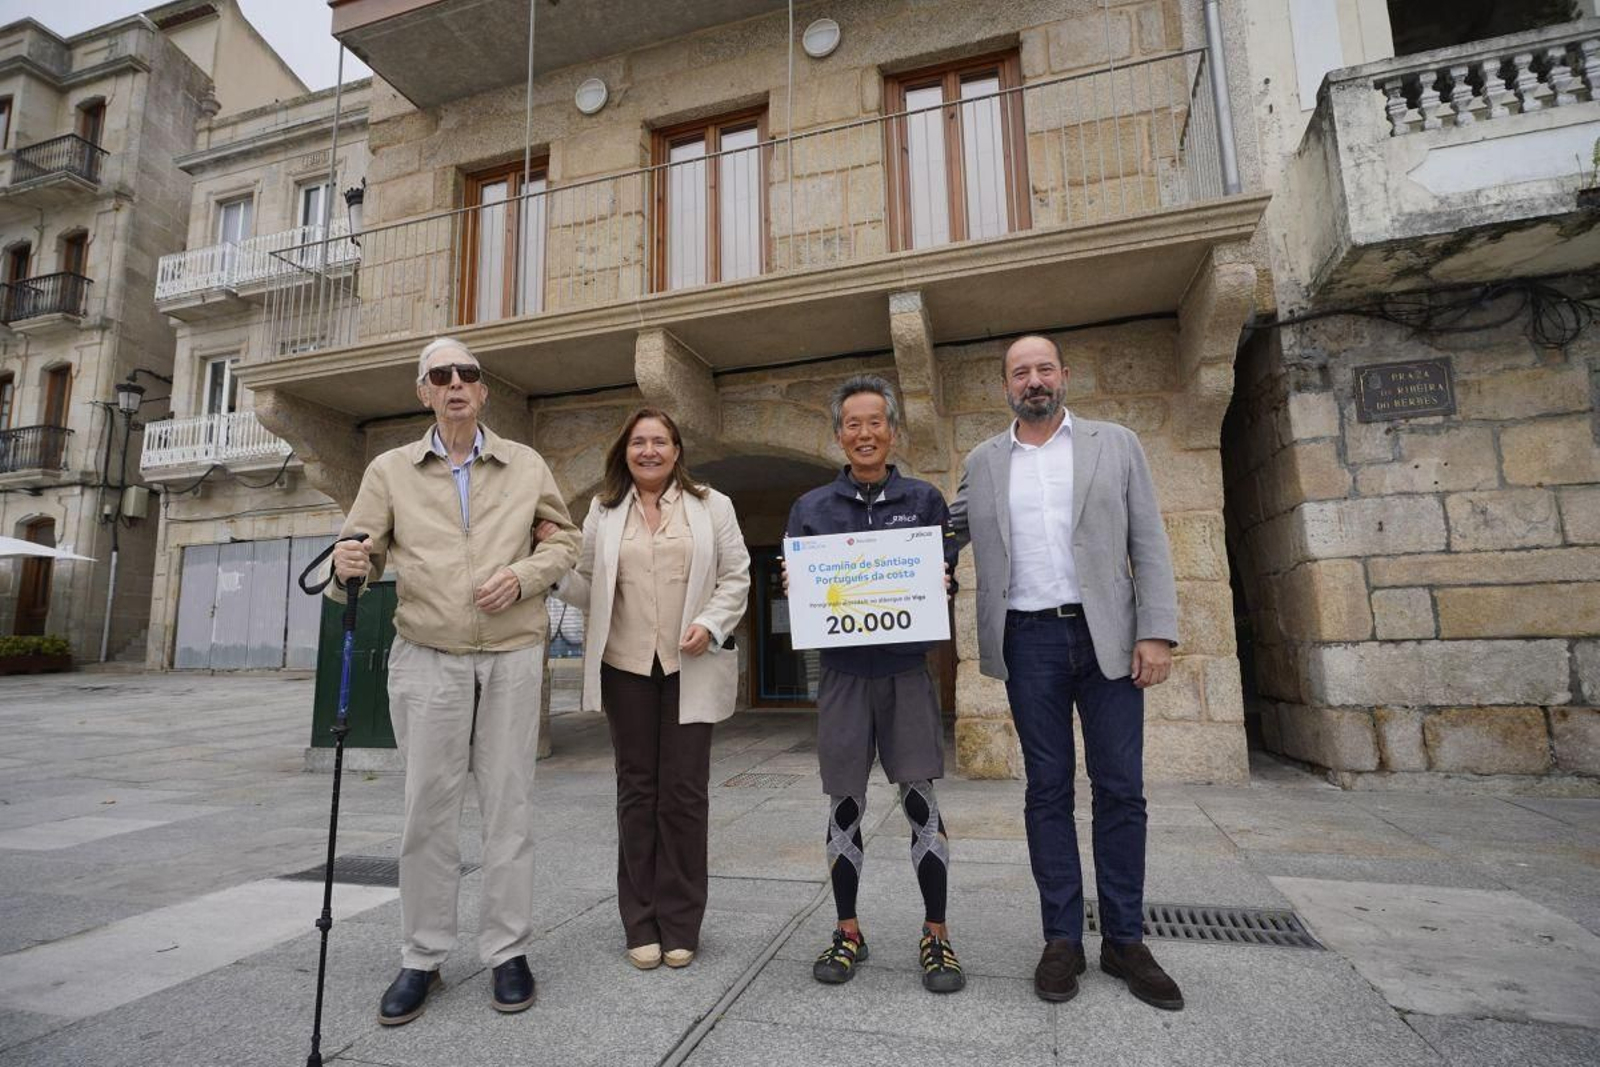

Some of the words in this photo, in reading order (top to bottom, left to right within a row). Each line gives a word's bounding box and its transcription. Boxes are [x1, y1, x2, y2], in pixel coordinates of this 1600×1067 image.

[1397, 383, 1444, 396] RIBEIRA
[808, 564, 817, 573] O
[818, 560, 857, 573] Camiño
[859, 560, 872, 569] de
[874, 557, 921, 568] Santiago
[871, 572, 885, 581] da
[886, 570, 916, 580] costa
[826, 610, 912, 635] 20.000
